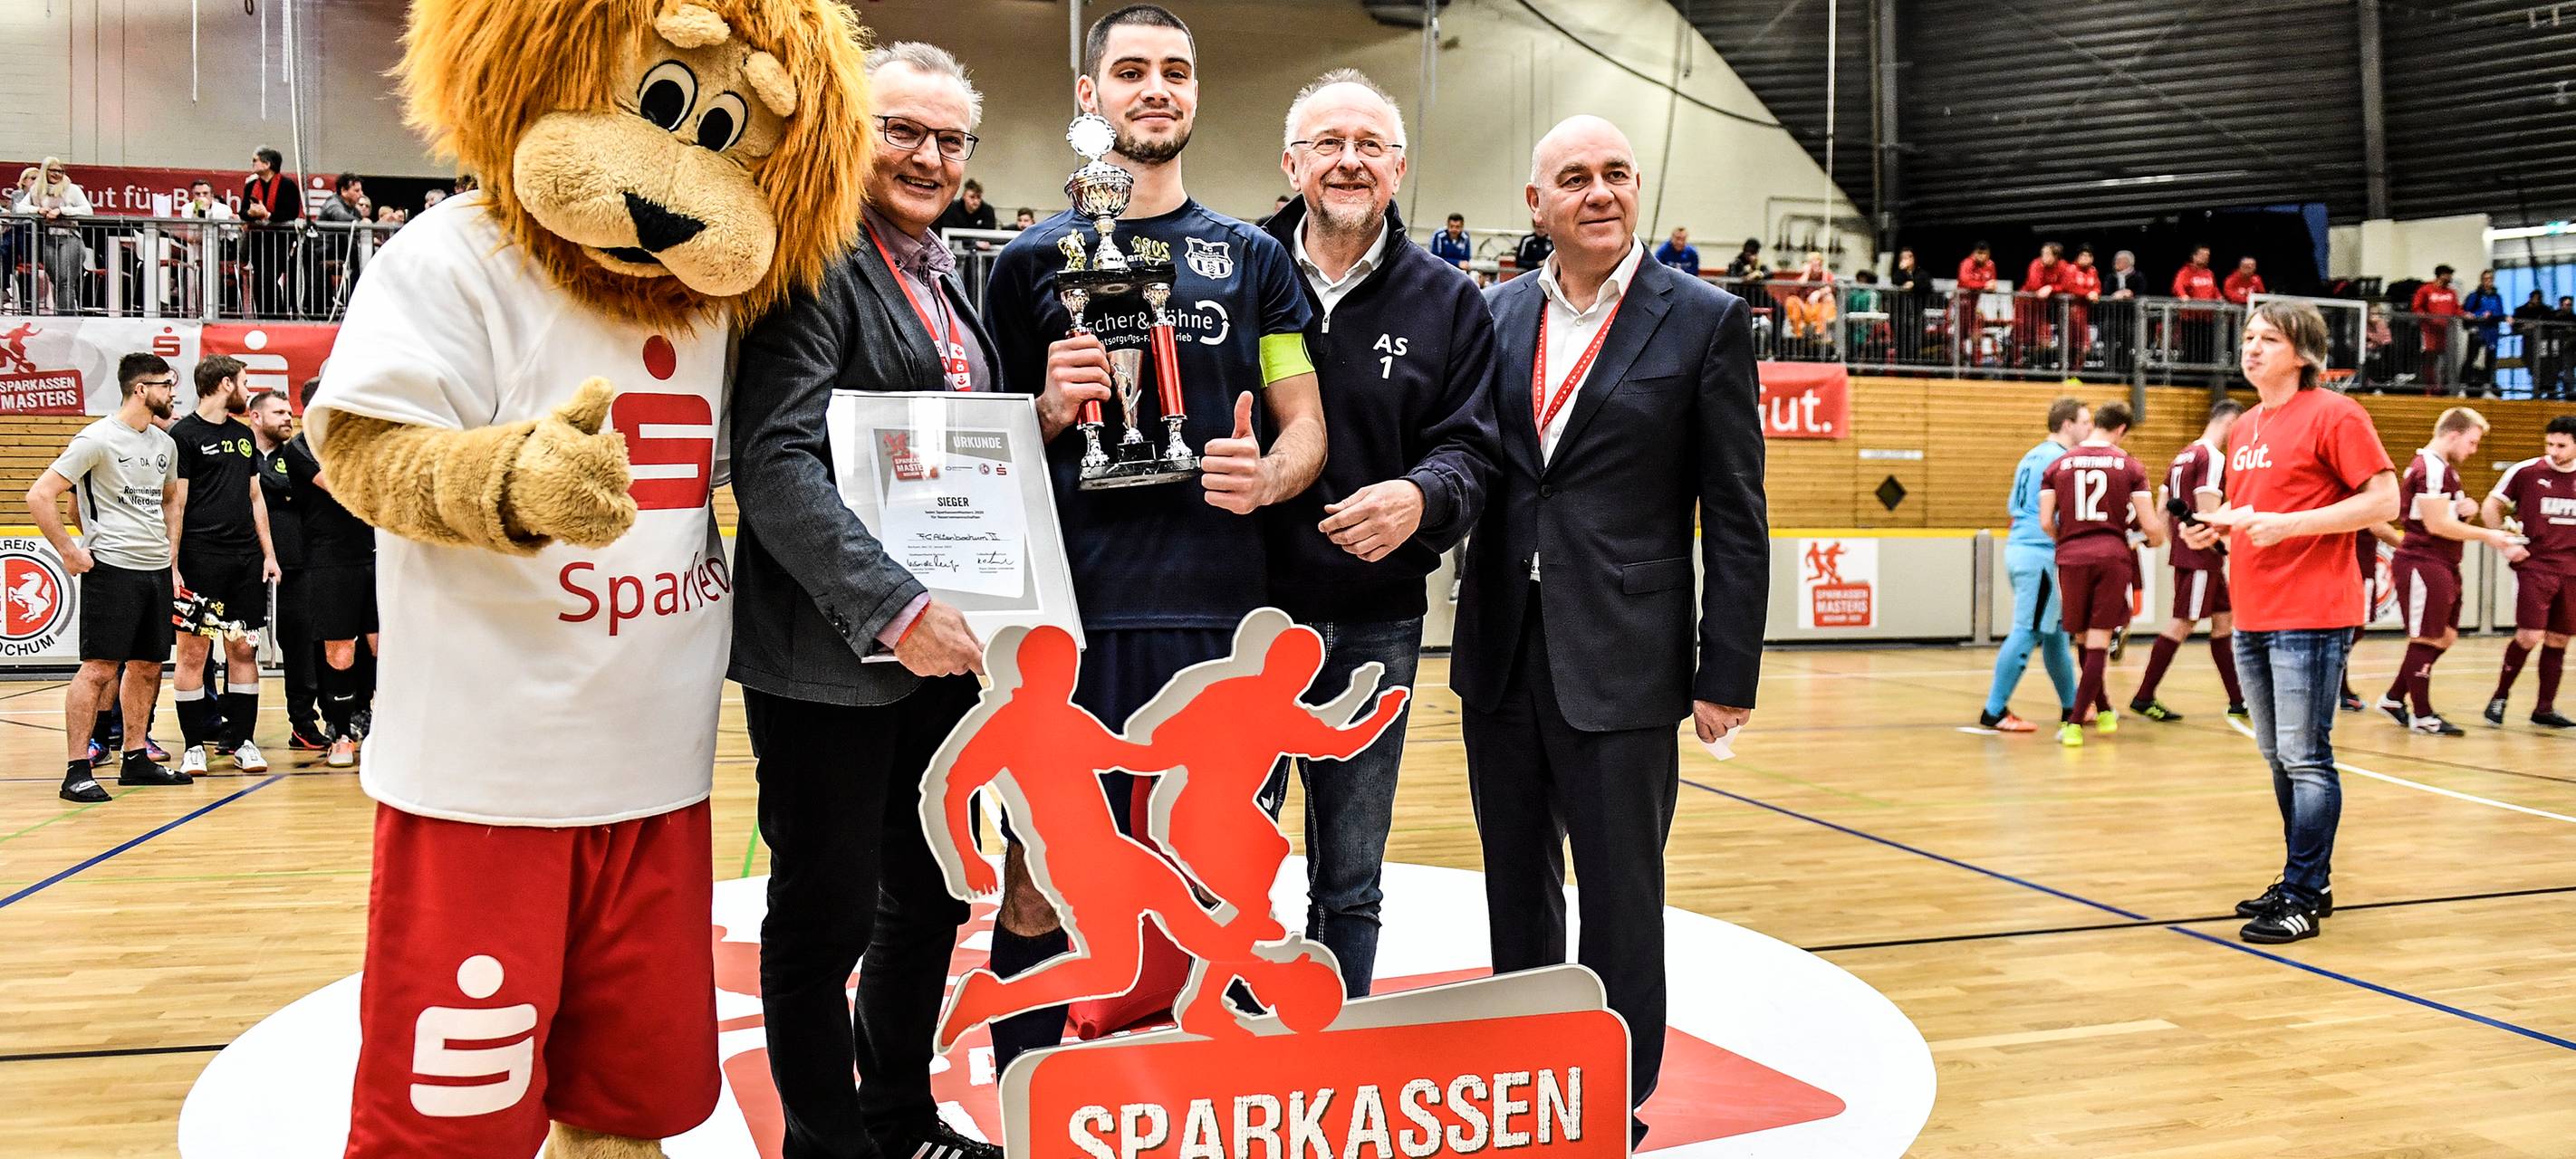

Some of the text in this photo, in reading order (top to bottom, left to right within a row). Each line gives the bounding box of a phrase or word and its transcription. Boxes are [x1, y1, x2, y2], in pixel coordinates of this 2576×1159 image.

[79, 185, 116, 208] ut
[1166, 308, 1213, 330] öhne
[1372, 333, 1408, 356] AS
[1379, 355, 1393, 379] 1
[0, 377, 76, 393] SPARKASSEN
[1, 390, 77, 409] MASTERS
[221, 440, 235, 453] 22
[953, 436, 1003, 449] URKUNDE
[2232, 444, 2273, 472] Gut.
[937, 496, 970, 507] SIEGER
[2074, 469, 2108, 522] 12
[0, 635, 54, 656] CHUM
[1068, 1065, 1582, 1159] SPARKASSEN
